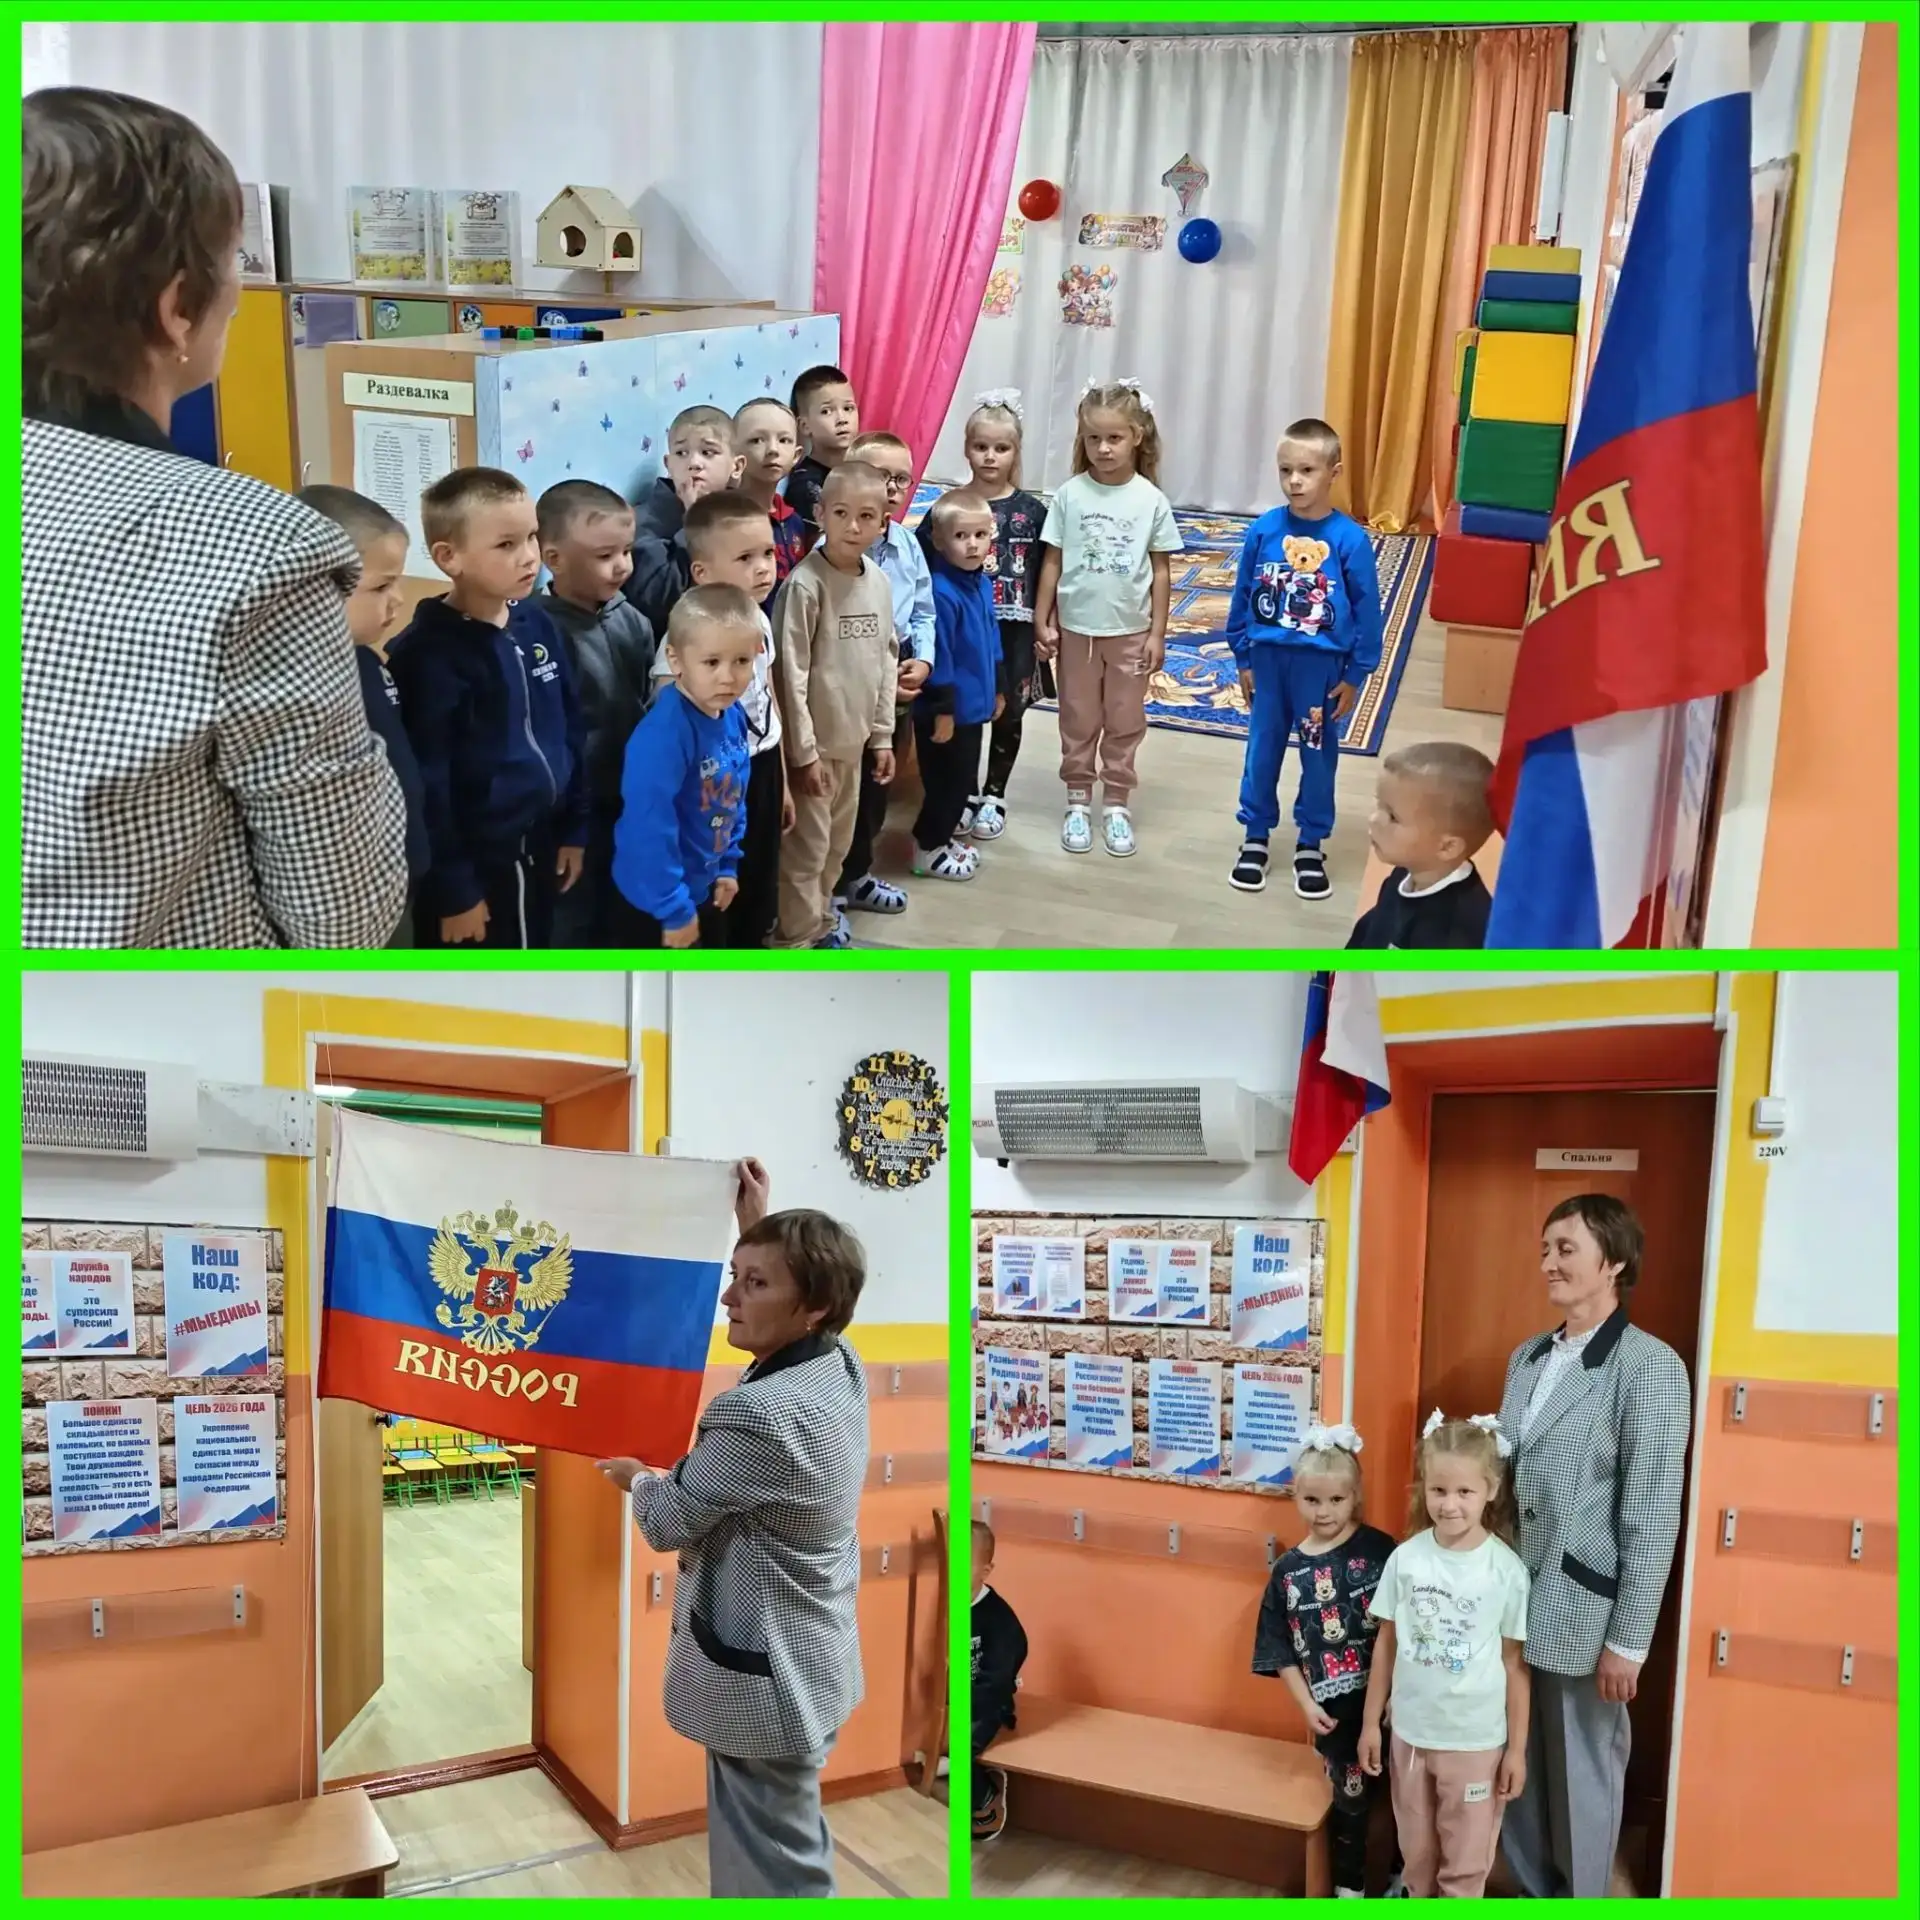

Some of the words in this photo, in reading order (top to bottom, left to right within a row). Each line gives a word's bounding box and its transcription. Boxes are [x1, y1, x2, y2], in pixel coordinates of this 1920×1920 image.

[368, 380, 449, 400] Раздевалка
[839, 620, 879, 639] BOSS
[868, 1057, 886, 1072] 11
[892, 1050, 911, 1066] 12
[918, 1066, 926, 1080] 1
[852, 1077, 870, 1092] 10
[933, 1088, 944, 1102] 2
[844, 1106, 856, 1123] 9
[936, 1118, 945, 1132] 3
[850, 1136, 861, 1152] 8
[928, 1143, 937, 1160] 4
[1759, 1146, 1787, 1157] 220V
[1561, 1150, 1612, 1163] Спальня
[865, 1160, 875, 1177] 7
[911, 1163, 920, 1179] 5
[888, 1171, 898, 1186] 6
[1254, 1234, 1289, 1252] Наш
[192, 1245, 238, 1266] Наш
[70, 1262, 109, 1271] Дружба
[1252, 1258, 1288, 1277] код:
[69, 1275, 111, 1284] народов
[193, 1273, 239, 1293] код:
[83, 1297, 100, 1305] это
[1237, 1283, 1303, 1312] #МЫЕДИНЫ
[65, 1308, 118, 1317] суперсила
[174, 1300, 262, 1336] #МЫЕДИНЫ
[73, 1319, 112, 1327] России!
[1242, 1371, 1261, 1381] ЦЕЛЬ
[1284, 1374, 1303, 1384] ГОДА
[83, 1405, 121, 1416] ПОМНИ!
[185, 1404, 211, 1415] ЦЕЛЬ
[213, 1403, 237, 1413] 2026
[240, 1402, 265, 1413] ГОДА
[202, 1424, 249, 1432] Укрепление
